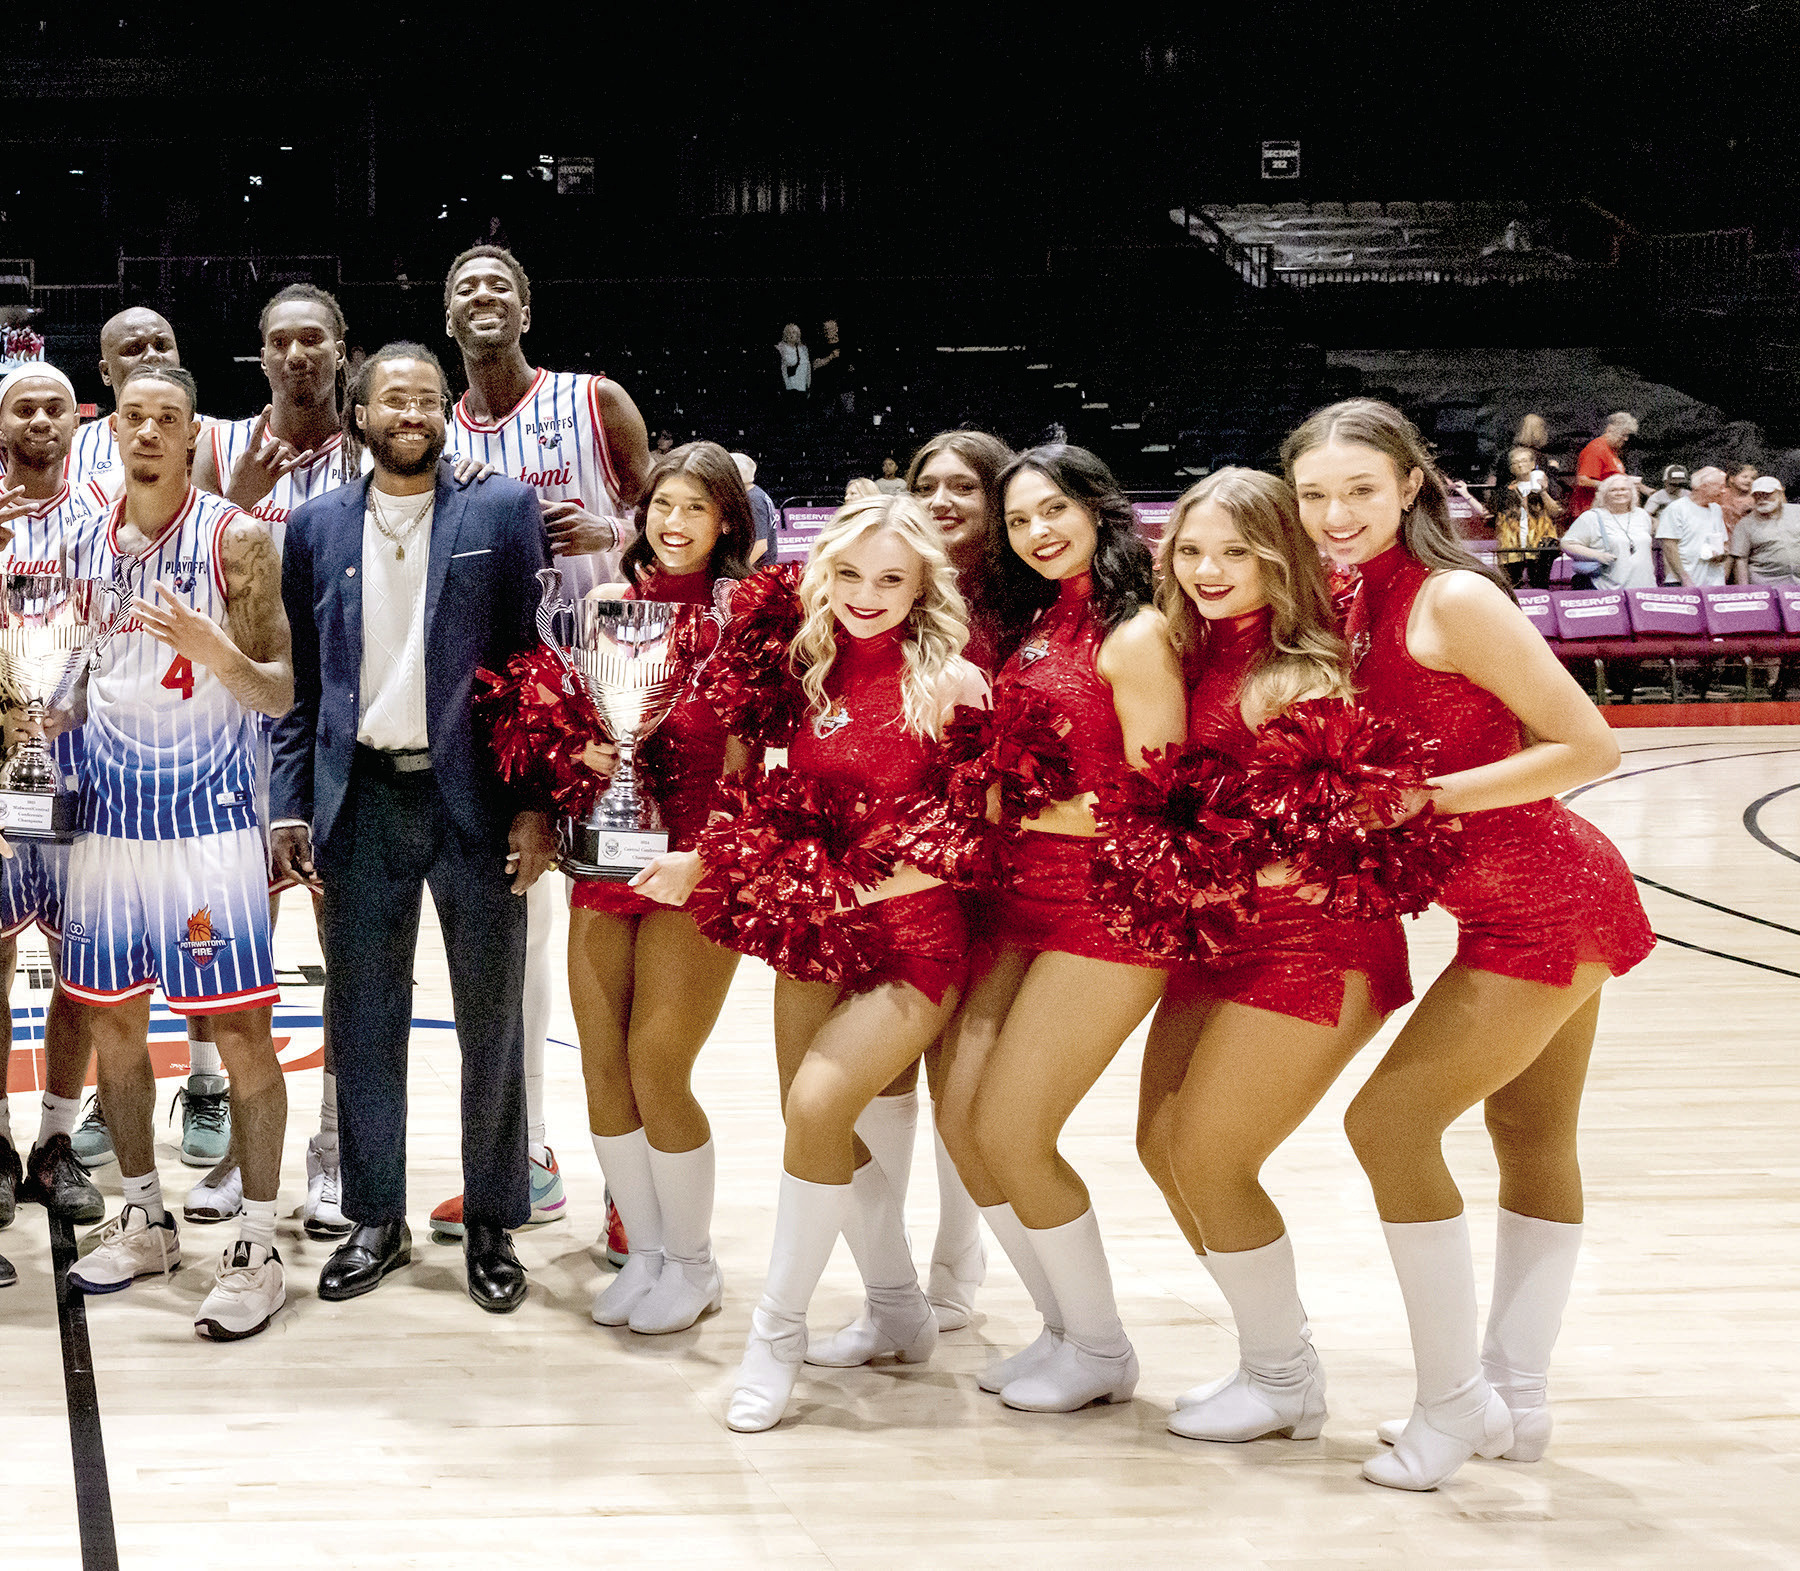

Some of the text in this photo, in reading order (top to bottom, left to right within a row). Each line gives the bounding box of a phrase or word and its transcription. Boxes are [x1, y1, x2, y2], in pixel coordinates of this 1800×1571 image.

[1264, 149, 1297, 158] SECTION
[525, 416, 573, 435] PLAYOFFS
[164, 561, 207, 575] PLAYOFF
[1560, 594, 1621, 607] RESERVED
[1636, 592, 1701, 604] RESERVED
[1707, 591, 1770, 602] RESERVED
[160, 653, 195, 700] 4
[179, 940, 227, 949] POTAWATOMI
[191, 948, 214, 957] FIRE
